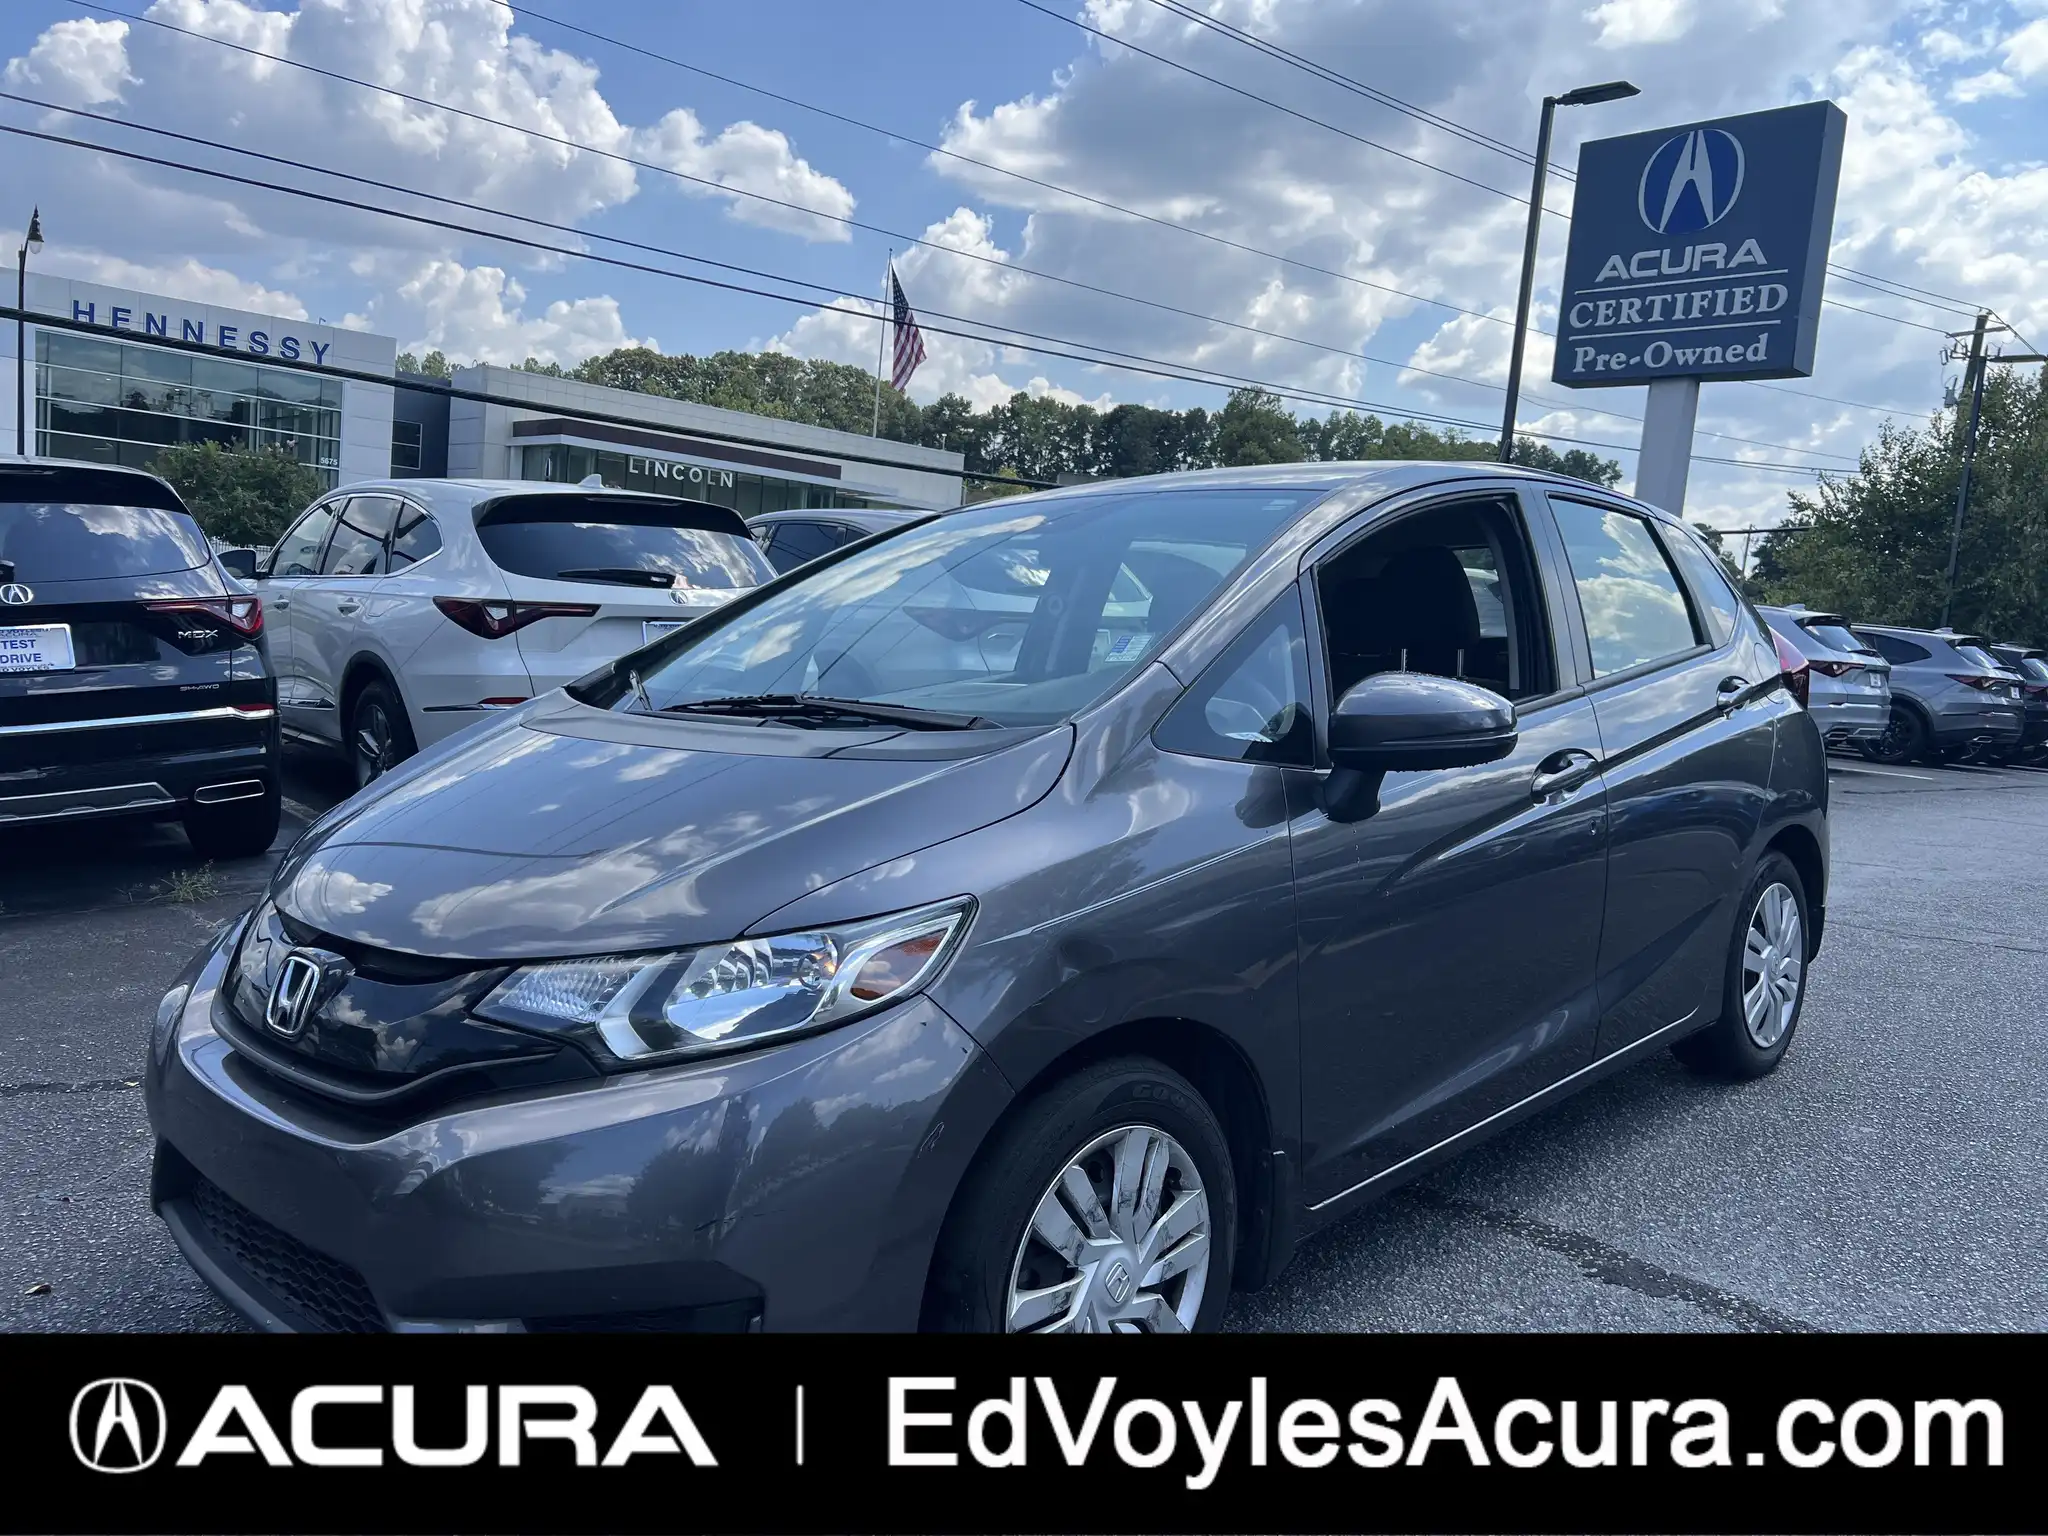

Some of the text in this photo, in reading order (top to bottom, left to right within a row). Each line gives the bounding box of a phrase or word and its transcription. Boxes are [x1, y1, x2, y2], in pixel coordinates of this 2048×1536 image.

[1594, 238, 1768, 283] ACURA
[1569, 283, 1789, 330] CERTIFIED
[72, 300, 331, 365] HENNESSY
[1572, 332, 1769, 373] Pre-Owned
[320, 456, 338, 466] 5675
[628, 457, 734, 488] LINCOLN
[0, 639, 36, 650] TEST
[178, 629, 219, 639] MDX
[0, 653, 43, 664] DRIVE
